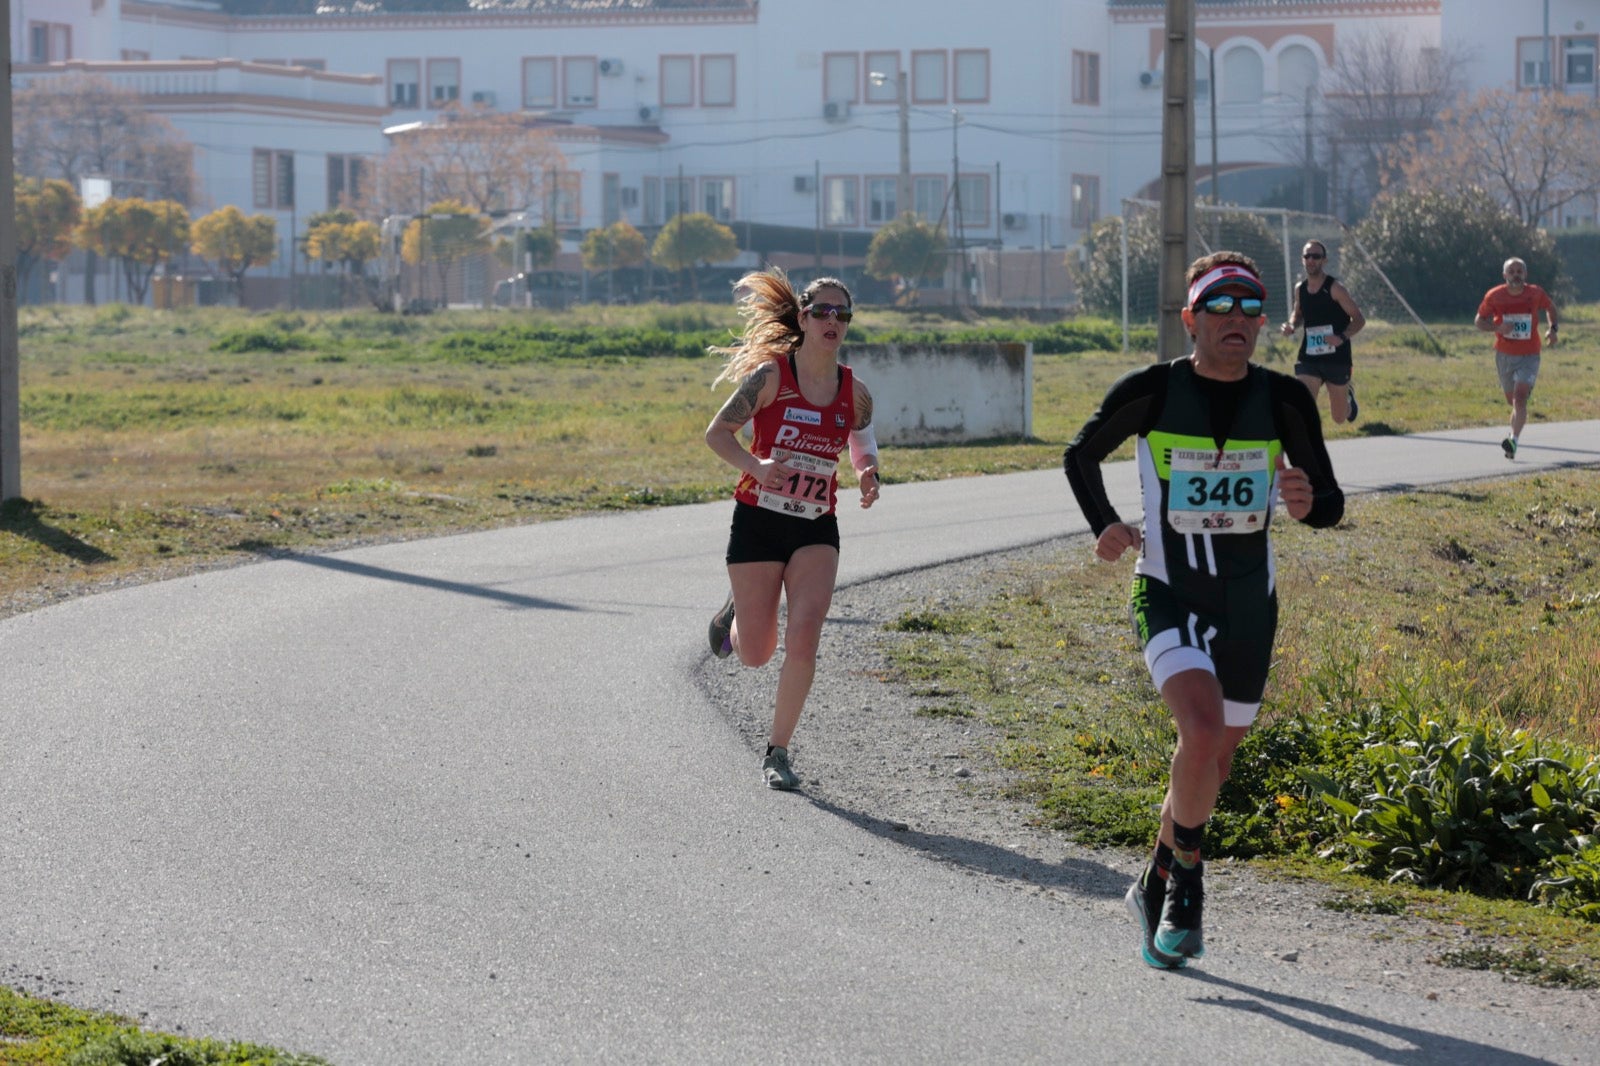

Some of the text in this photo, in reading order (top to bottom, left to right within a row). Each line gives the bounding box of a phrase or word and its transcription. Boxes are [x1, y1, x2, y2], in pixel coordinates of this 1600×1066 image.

[774, 425, 844, 454] Polisalud
[777, 473, 828, 501] 172
[1187, 477, 1254, 506] 346
